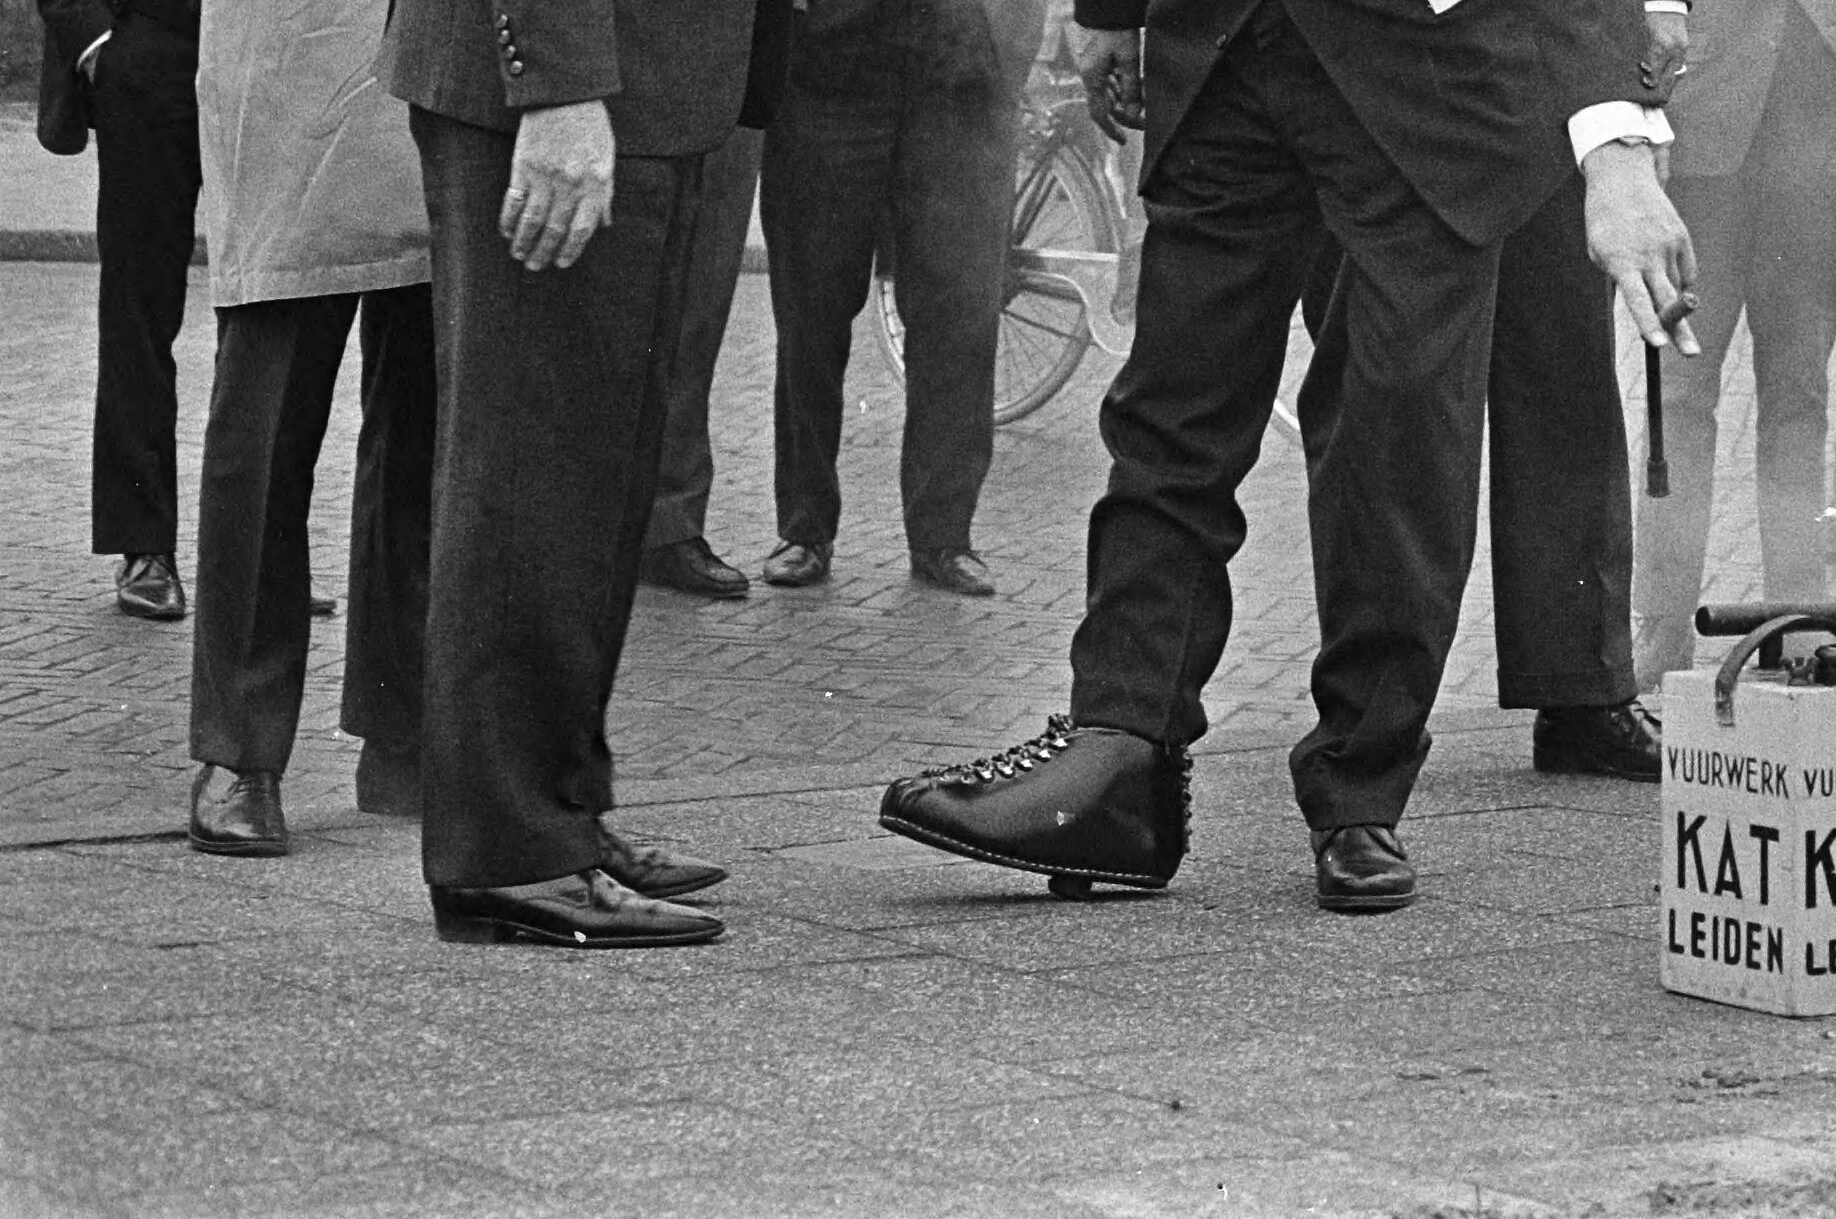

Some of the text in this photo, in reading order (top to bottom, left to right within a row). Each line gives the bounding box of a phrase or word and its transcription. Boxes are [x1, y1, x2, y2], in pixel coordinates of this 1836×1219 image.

[1668, 746, 1790, 800] VUURWERK
[1676, 811, 1780, 906] KAT
[1668, 908, 1784, 975] LEIDEN
